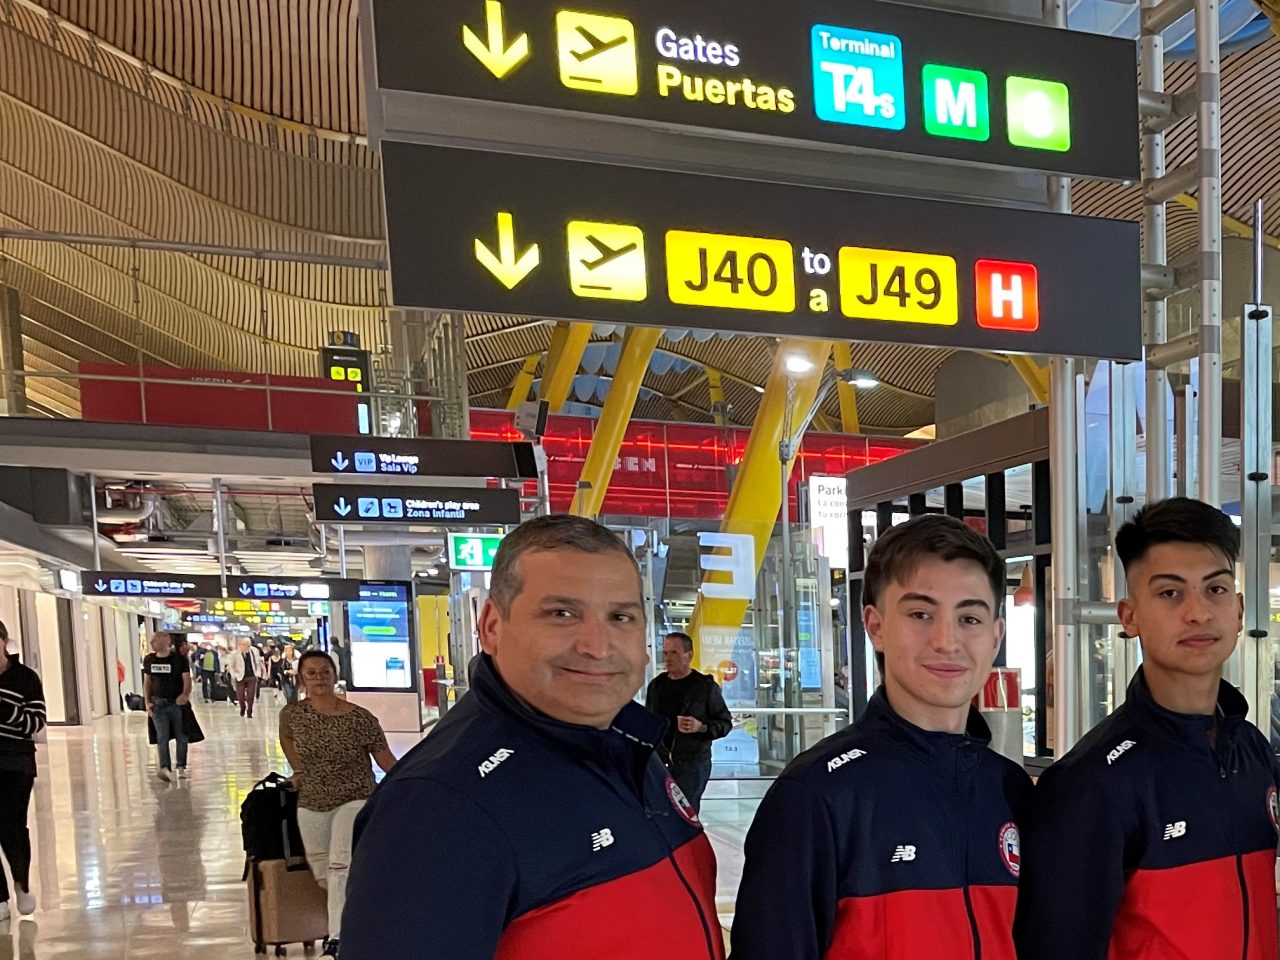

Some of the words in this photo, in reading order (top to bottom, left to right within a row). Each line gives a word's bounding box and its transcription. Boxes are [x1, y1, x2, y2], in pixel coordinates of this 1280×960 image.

[655, 27, 740, 66] Gates
[819, 31, 895, 59] Terminal
[657, 64, 795, 113] Puertas
[820, 61, 895, 119] T4s
[935, 78, 977, 127] M
[684, 247, 778, 297] J40
[802, 246, 831, 275] to
[856, 263, 942, 310] J49
[990, 273, 1023, 320] H
[809, 288, 829, 313] a
[381, 463, 401, 472] Sala
[402, 463, 417, 474] Vip
[818, 485, 847, 496] Park
[407, 509, 430, 518] Zona
[432, 508, 465, 519] Infantil
